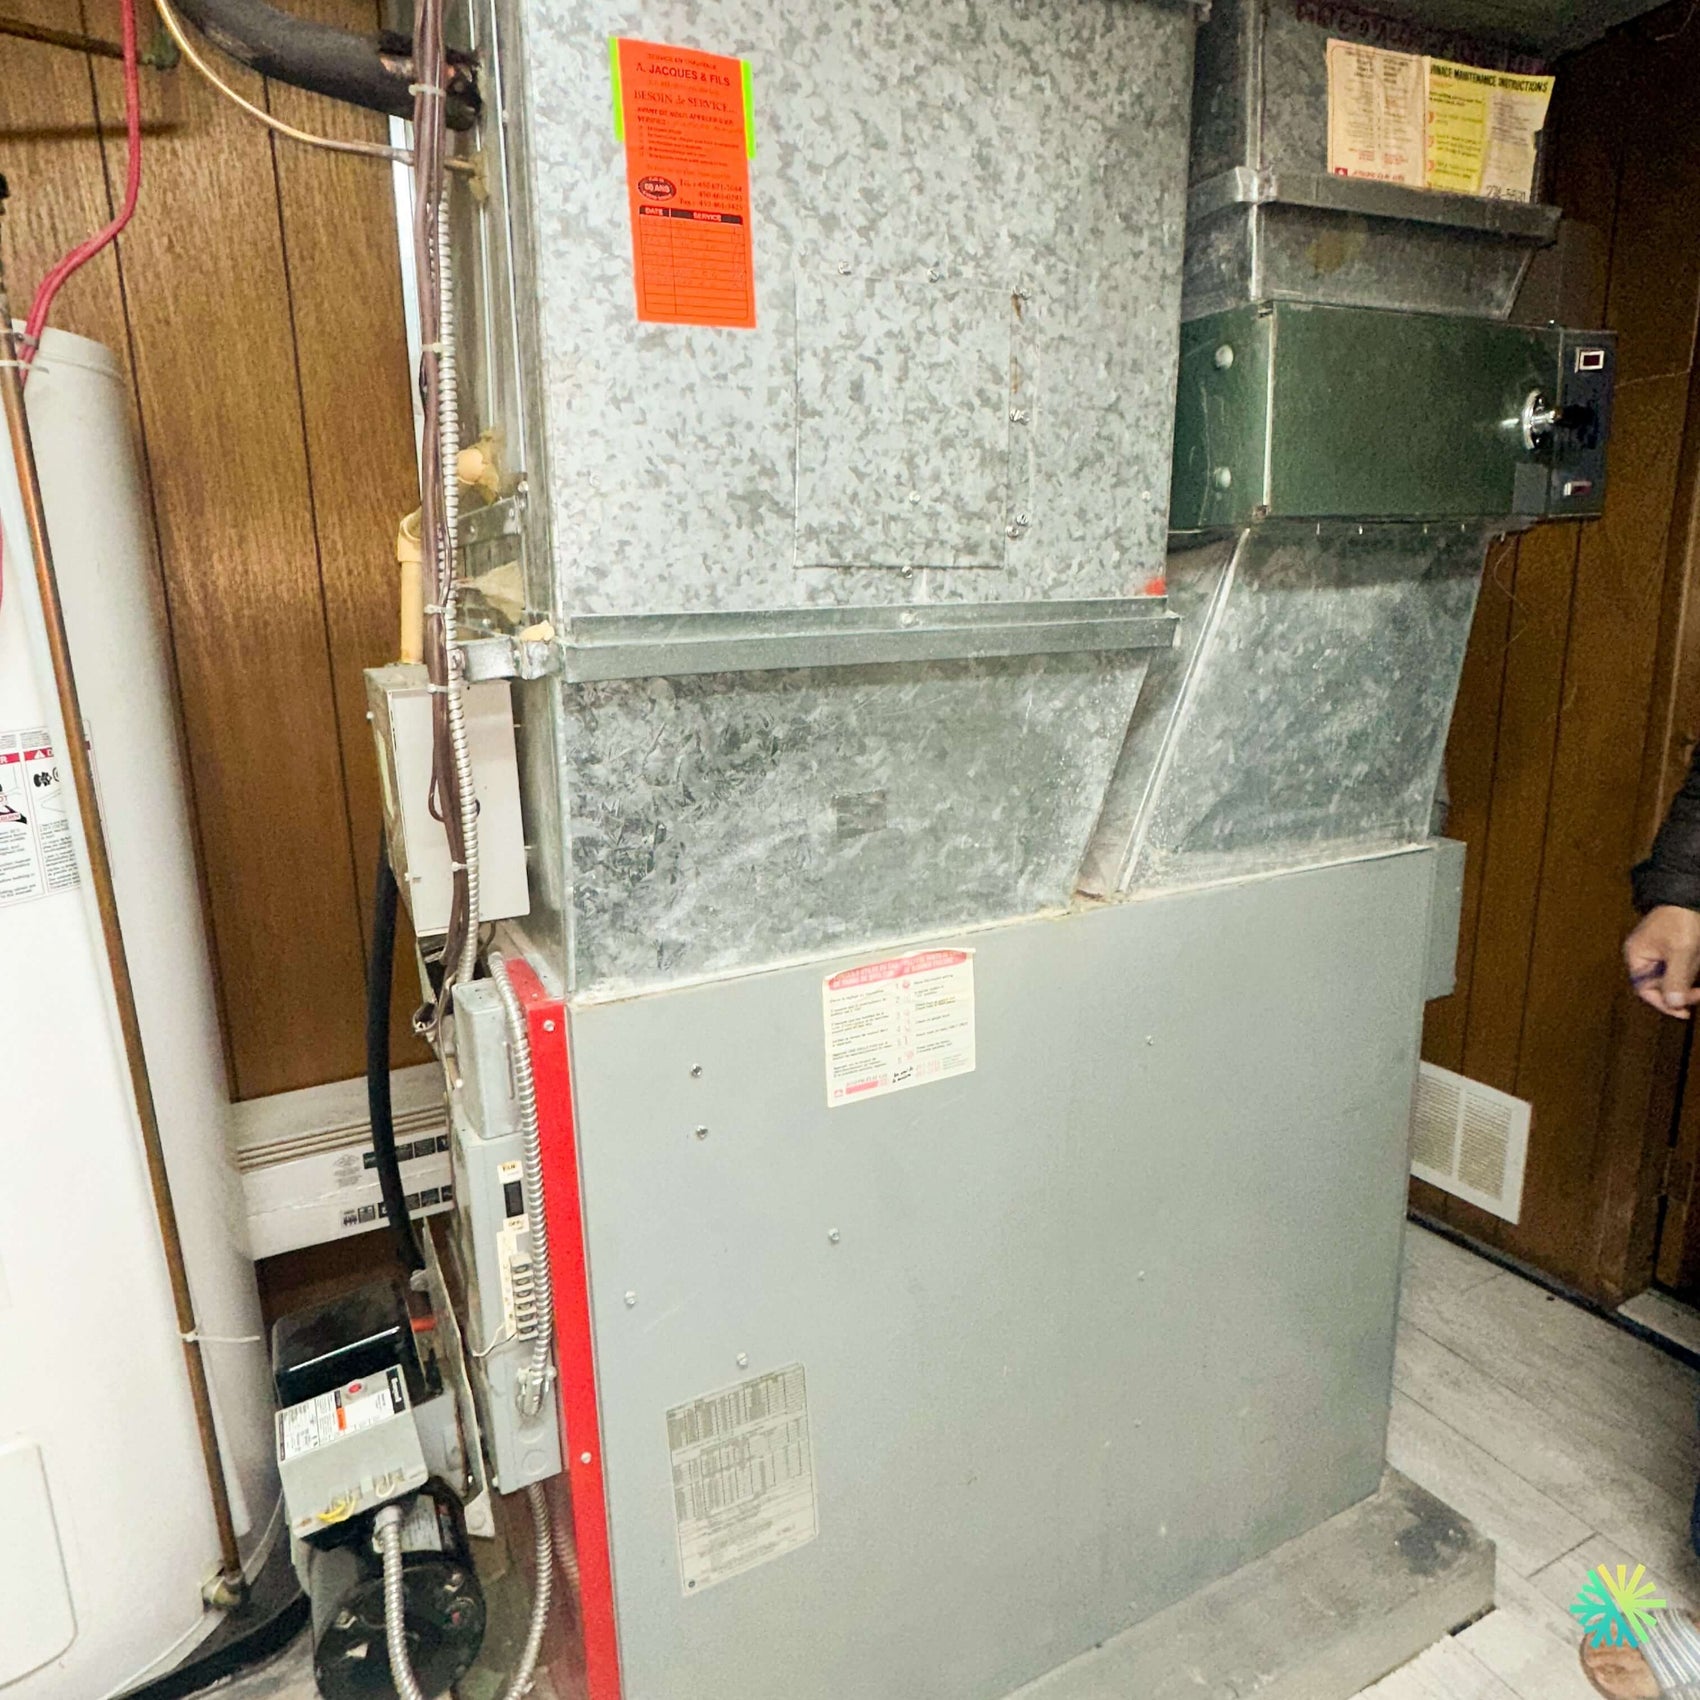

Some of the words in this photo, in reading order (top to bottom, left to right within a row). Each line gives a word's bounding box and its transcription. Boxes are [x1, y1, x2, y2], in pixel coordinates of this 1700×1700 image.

[649, 64, 698, 80] JACQUES
[700, 72, 708, 82] &
[710, 74, 730, 87] FILS
[634, 90, 673, 104] BESOIN
[644, 207, 663, 216] DATE
